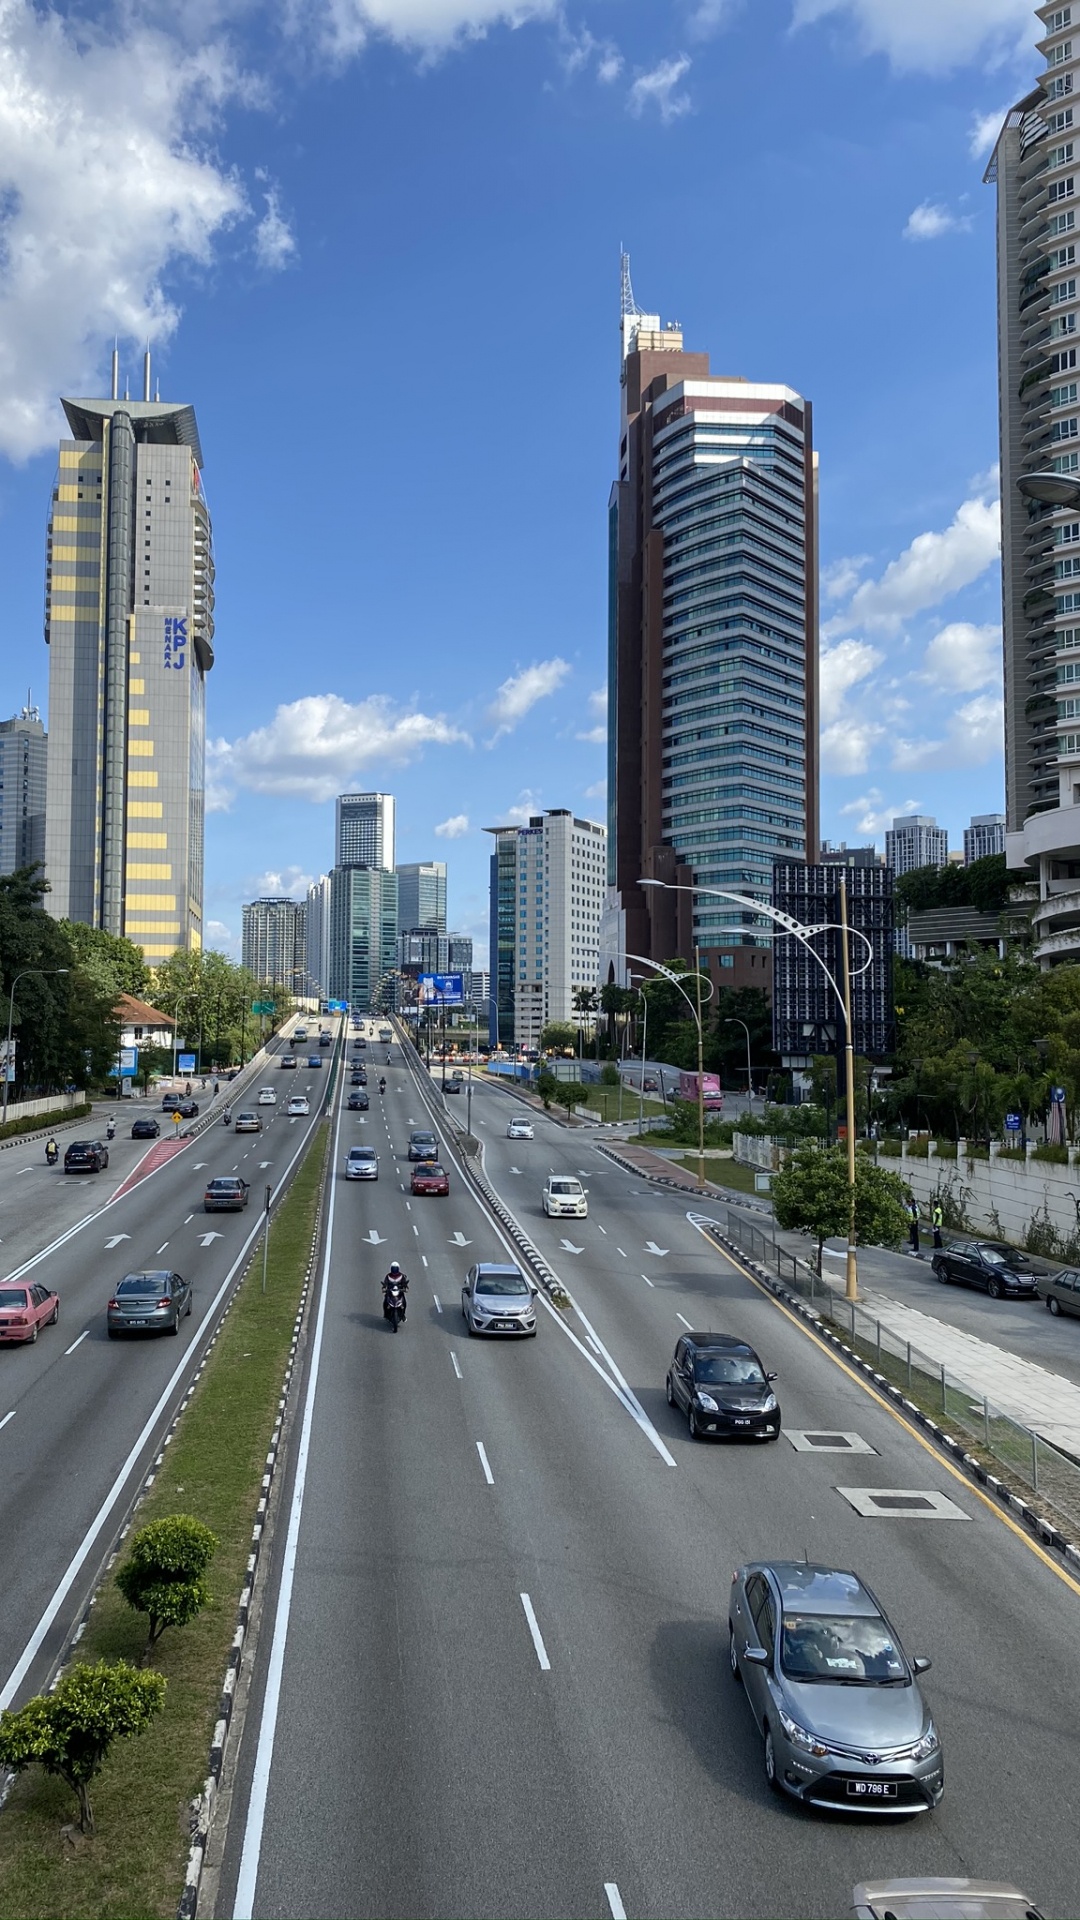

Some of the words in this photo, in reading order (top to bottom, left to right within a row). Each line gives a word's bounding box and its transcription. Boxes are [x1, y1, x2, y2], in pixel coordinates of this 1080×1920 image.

[164, 617, 172, 669] MENARA
[173, 617, 187, 670] KPJ
[855, 1782, 866, 1793] WD
[867, 1784, 882, 1794] 796
